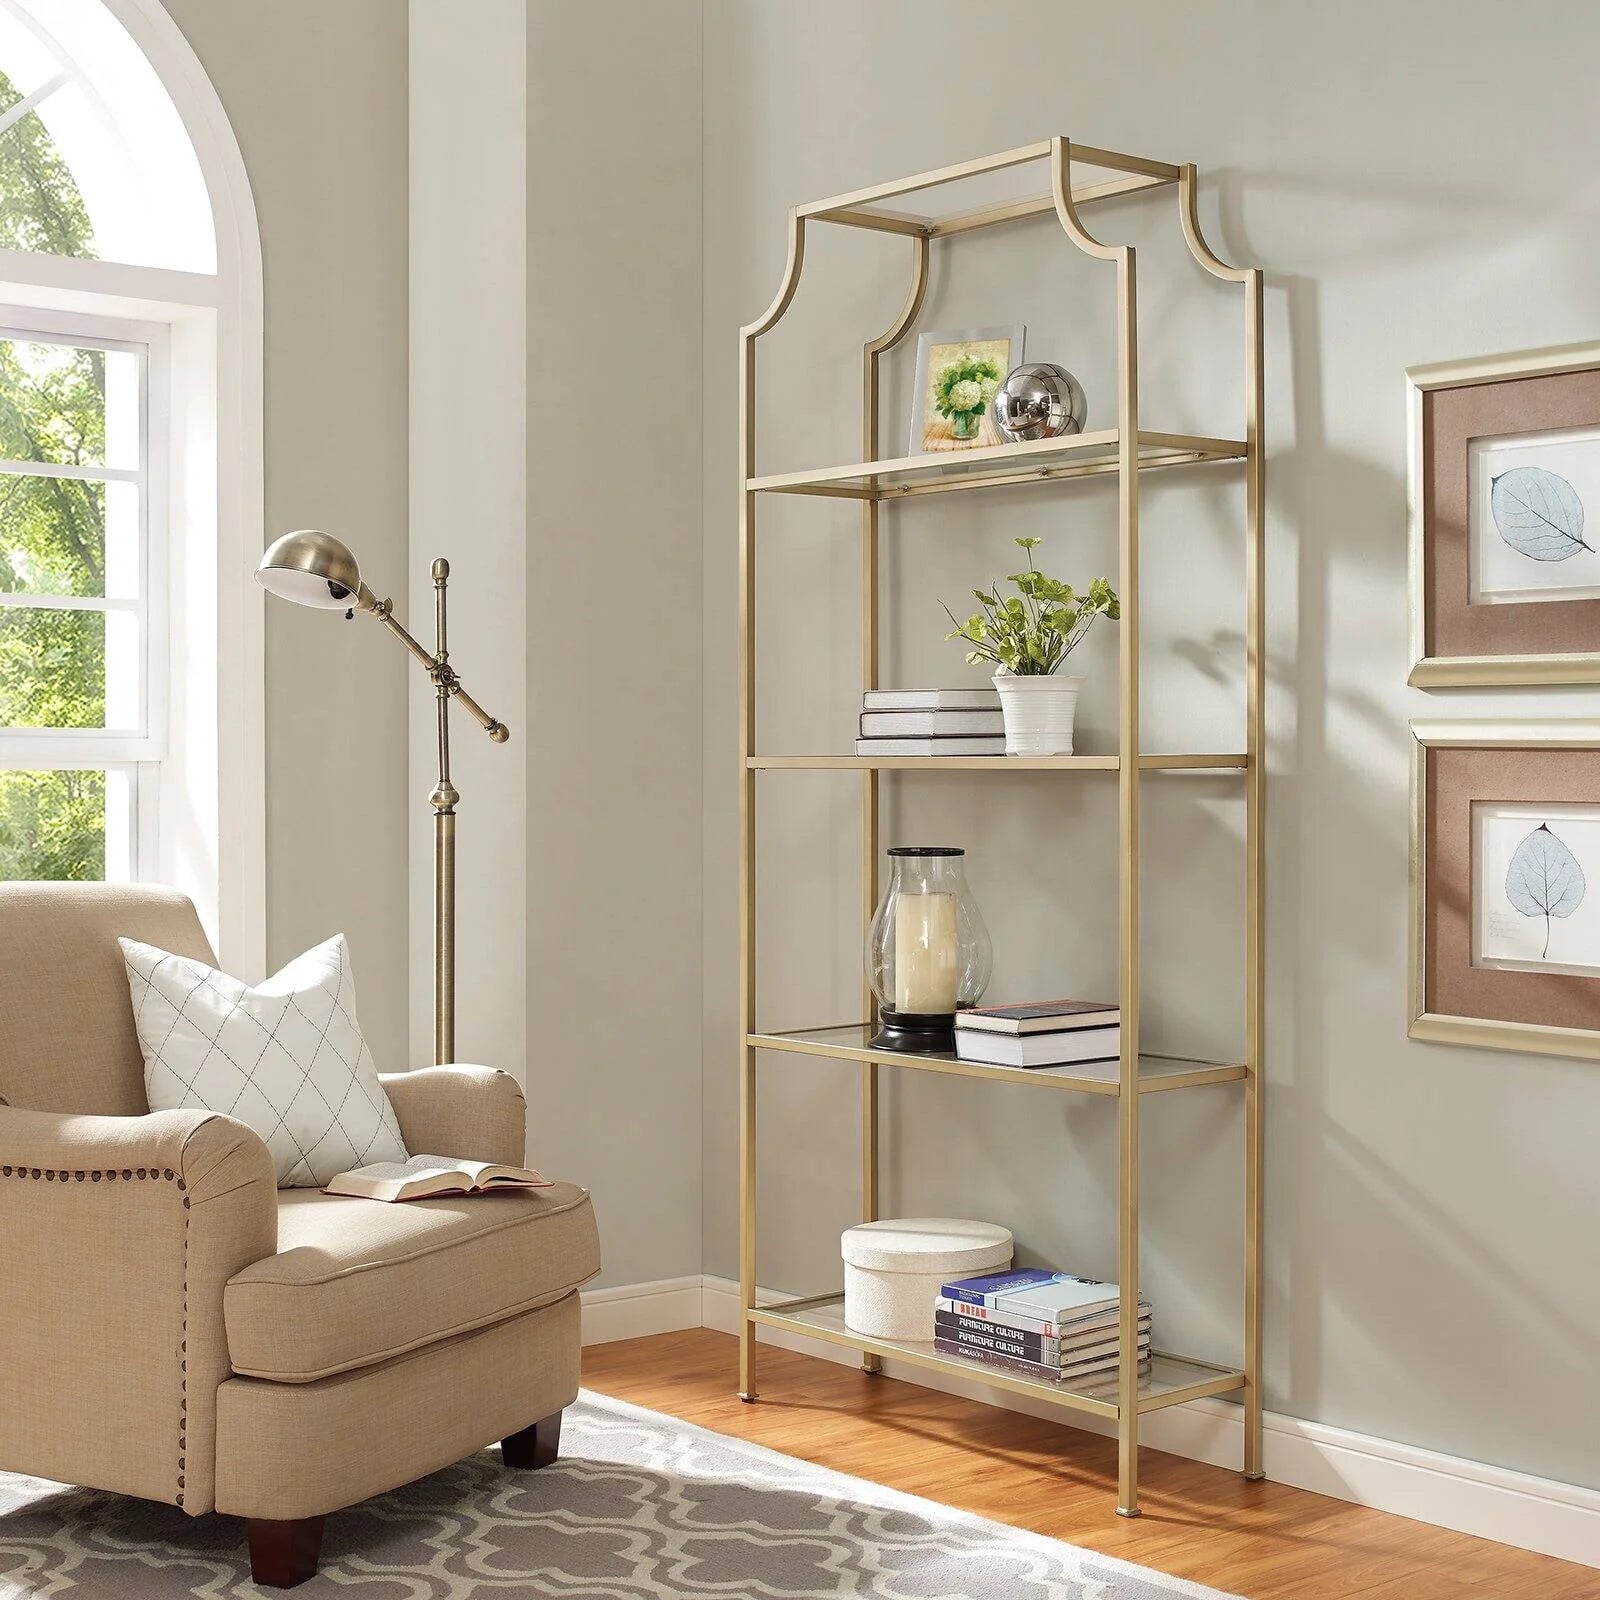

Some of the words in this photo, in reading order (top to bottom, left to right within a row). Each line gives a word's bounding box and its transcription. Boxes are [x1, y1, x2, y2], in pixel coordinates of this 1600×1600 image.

[958, 1317, 994, 1334] FURNITURE
[996, 1327, 1024, 1340] CULTURE
[958, 1331, 994, 1348] FURNITURE
[996, 1341, 1024, 1355] CULTURE
